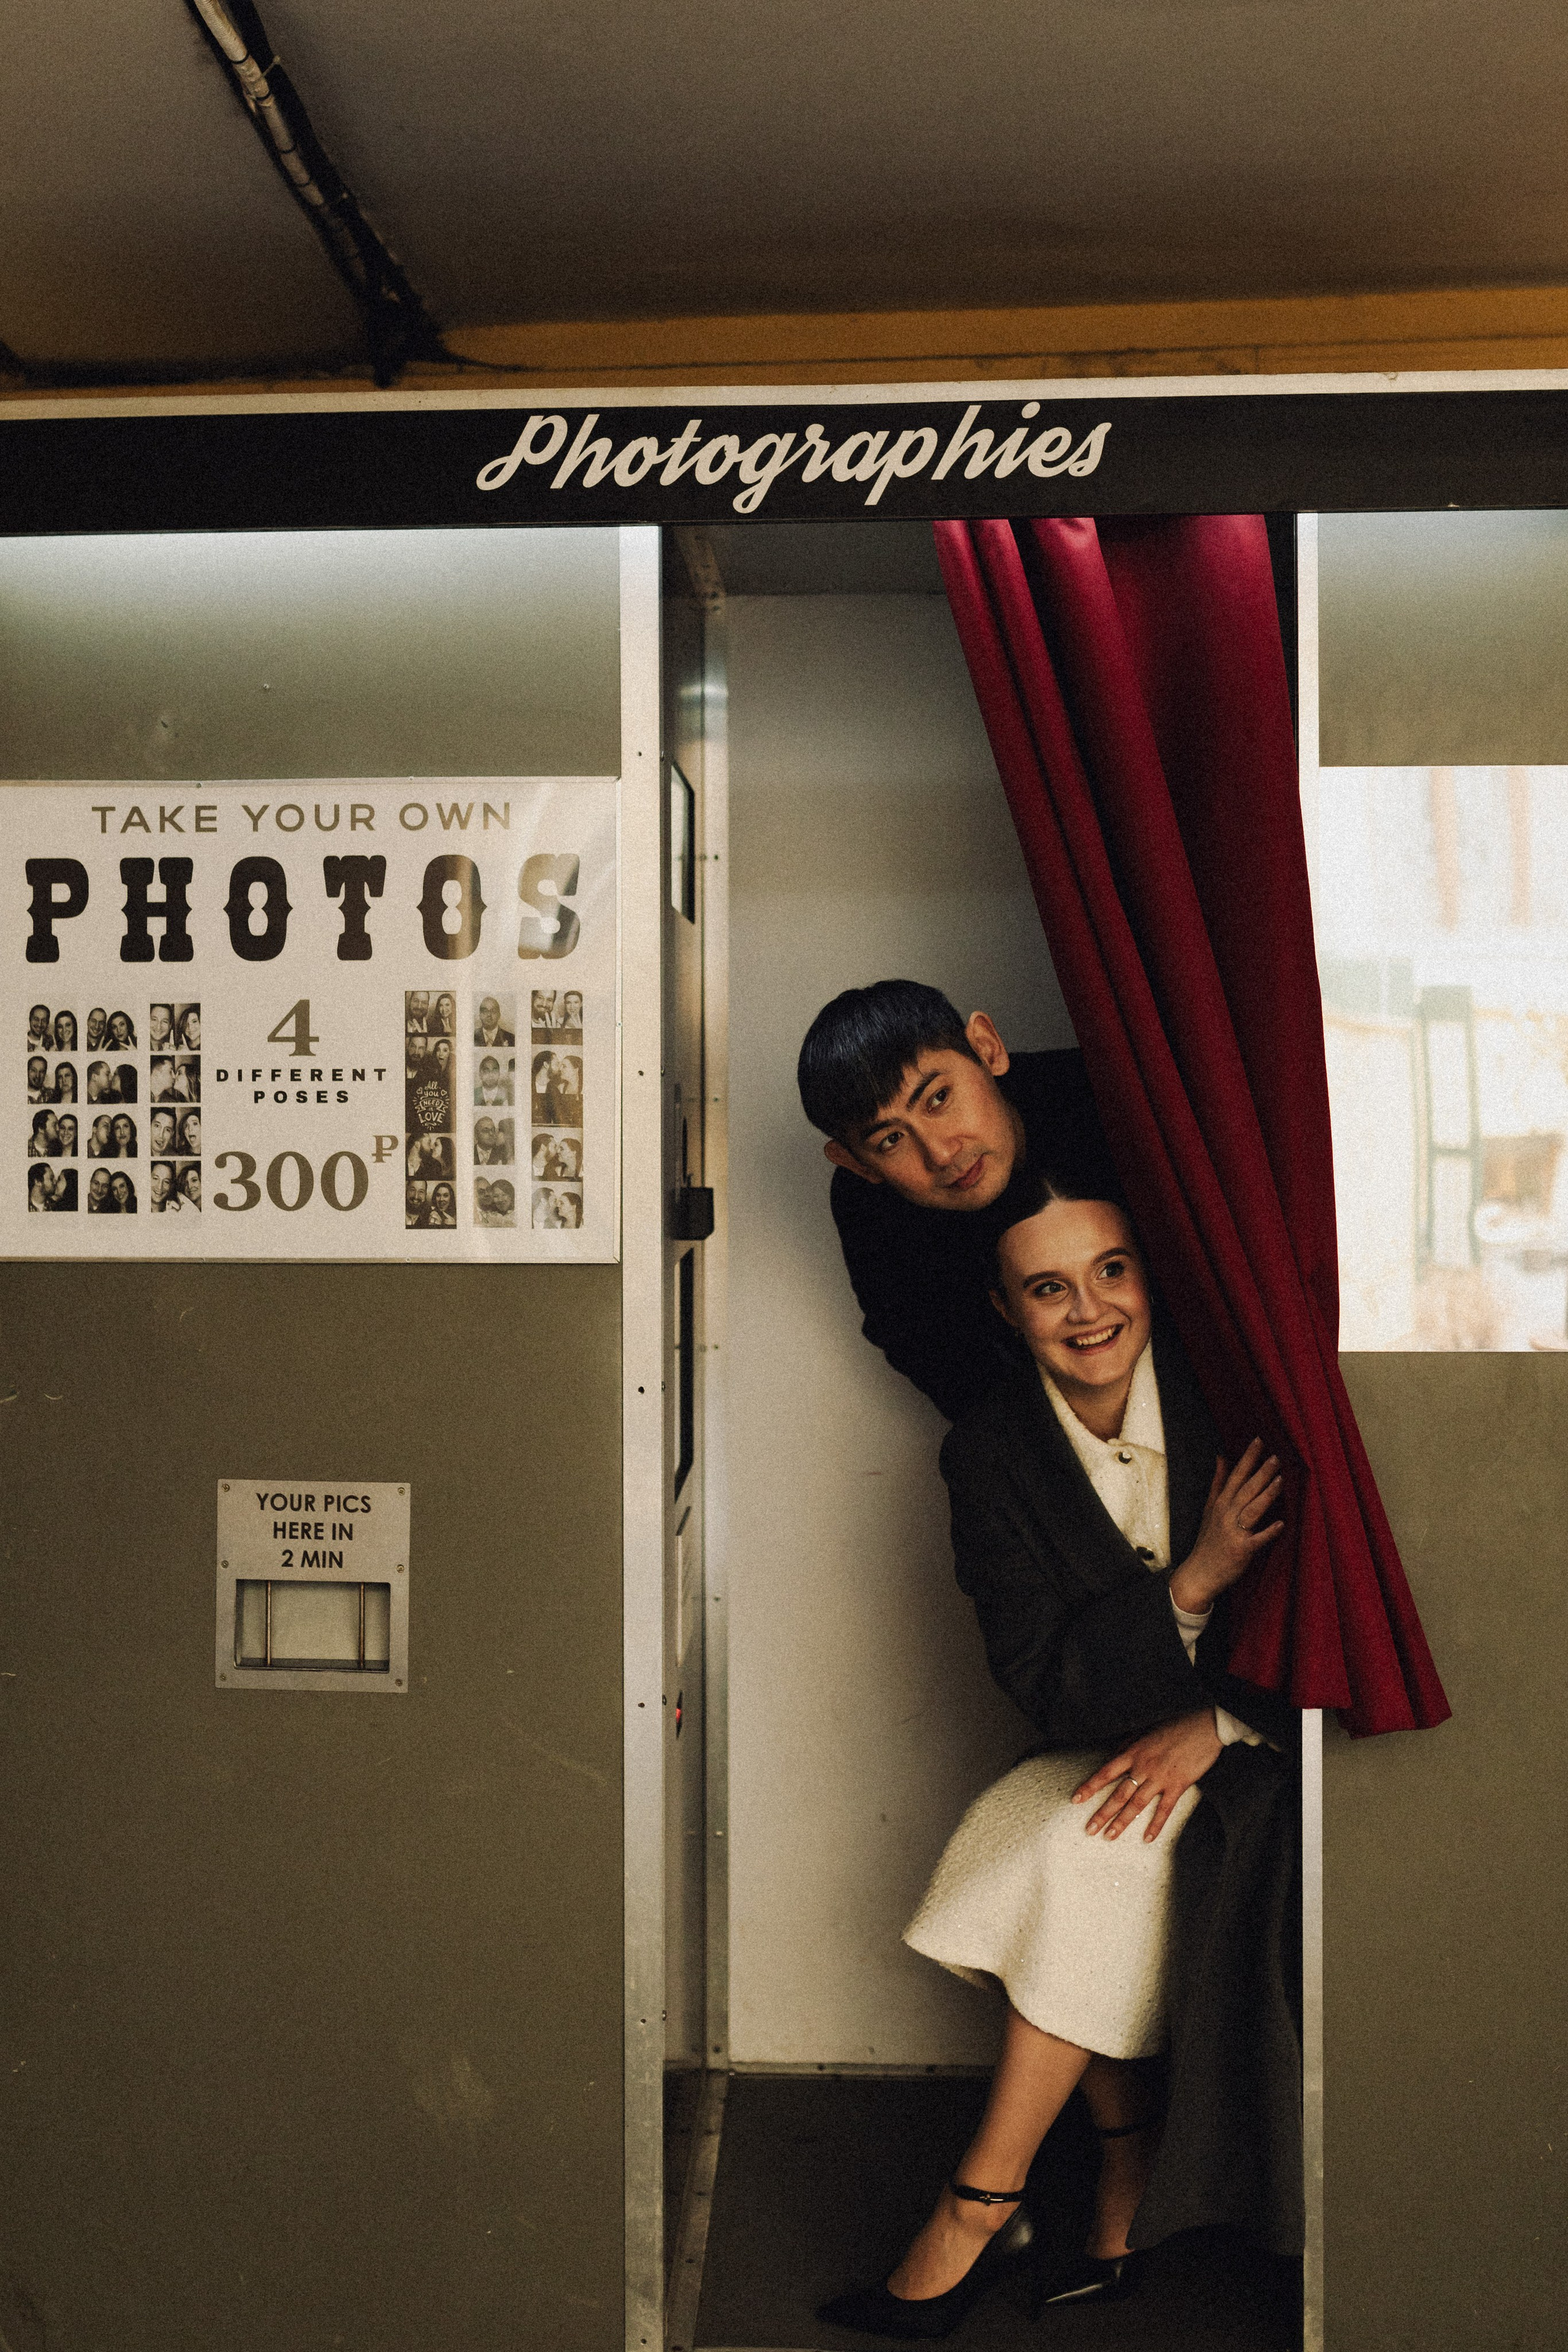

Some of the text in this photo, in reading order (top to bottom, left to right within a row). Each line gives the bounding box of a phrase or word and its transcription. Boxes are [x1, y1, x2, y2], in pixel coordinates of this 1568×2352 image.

[476, 401, 1112, 514] Photographies
[91, 802, 511, 834] TAKE YOUR OWN
[25, 853, 581, 963] PHOTOS
[267, 999, 319, 1057] 4
[216, 1068, 386, 1082] DIFFERENT
[254, 1090, 350, 1104] POSES
[418, 1112, 445, 1123] LOVE
[255, 1493, 372, 1513] YOUR PICS
[273, 1521, 353, 1540] HERE IN
[281, 1549, 344, 1569] 2 MIN
